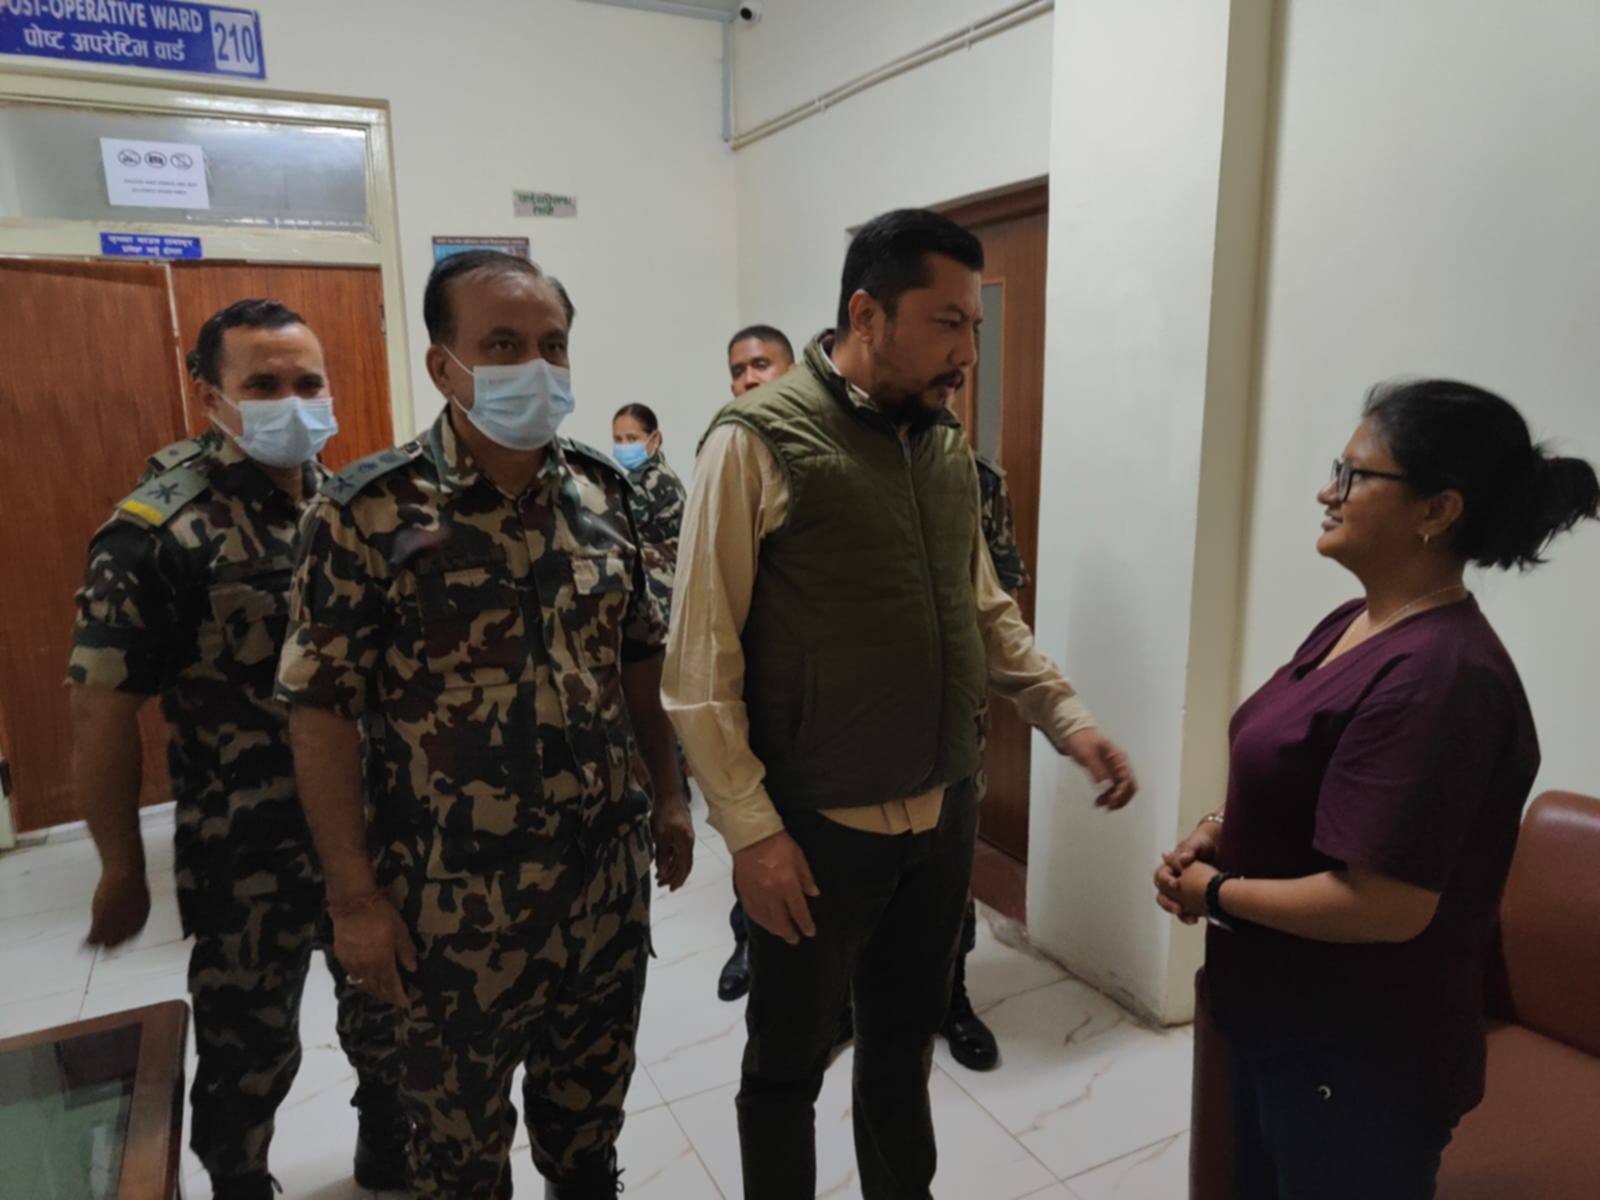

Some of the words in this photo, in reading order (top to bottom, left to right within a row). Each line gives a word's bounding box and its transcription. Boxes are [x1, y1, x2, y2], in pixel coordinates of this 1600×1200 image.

[150, 9, 203, 33] WARD
[23, 24, 66, 49] पोष्ट
[154, 39, 186, 62] वार्ड
[213, 22, 257, 65] 210
